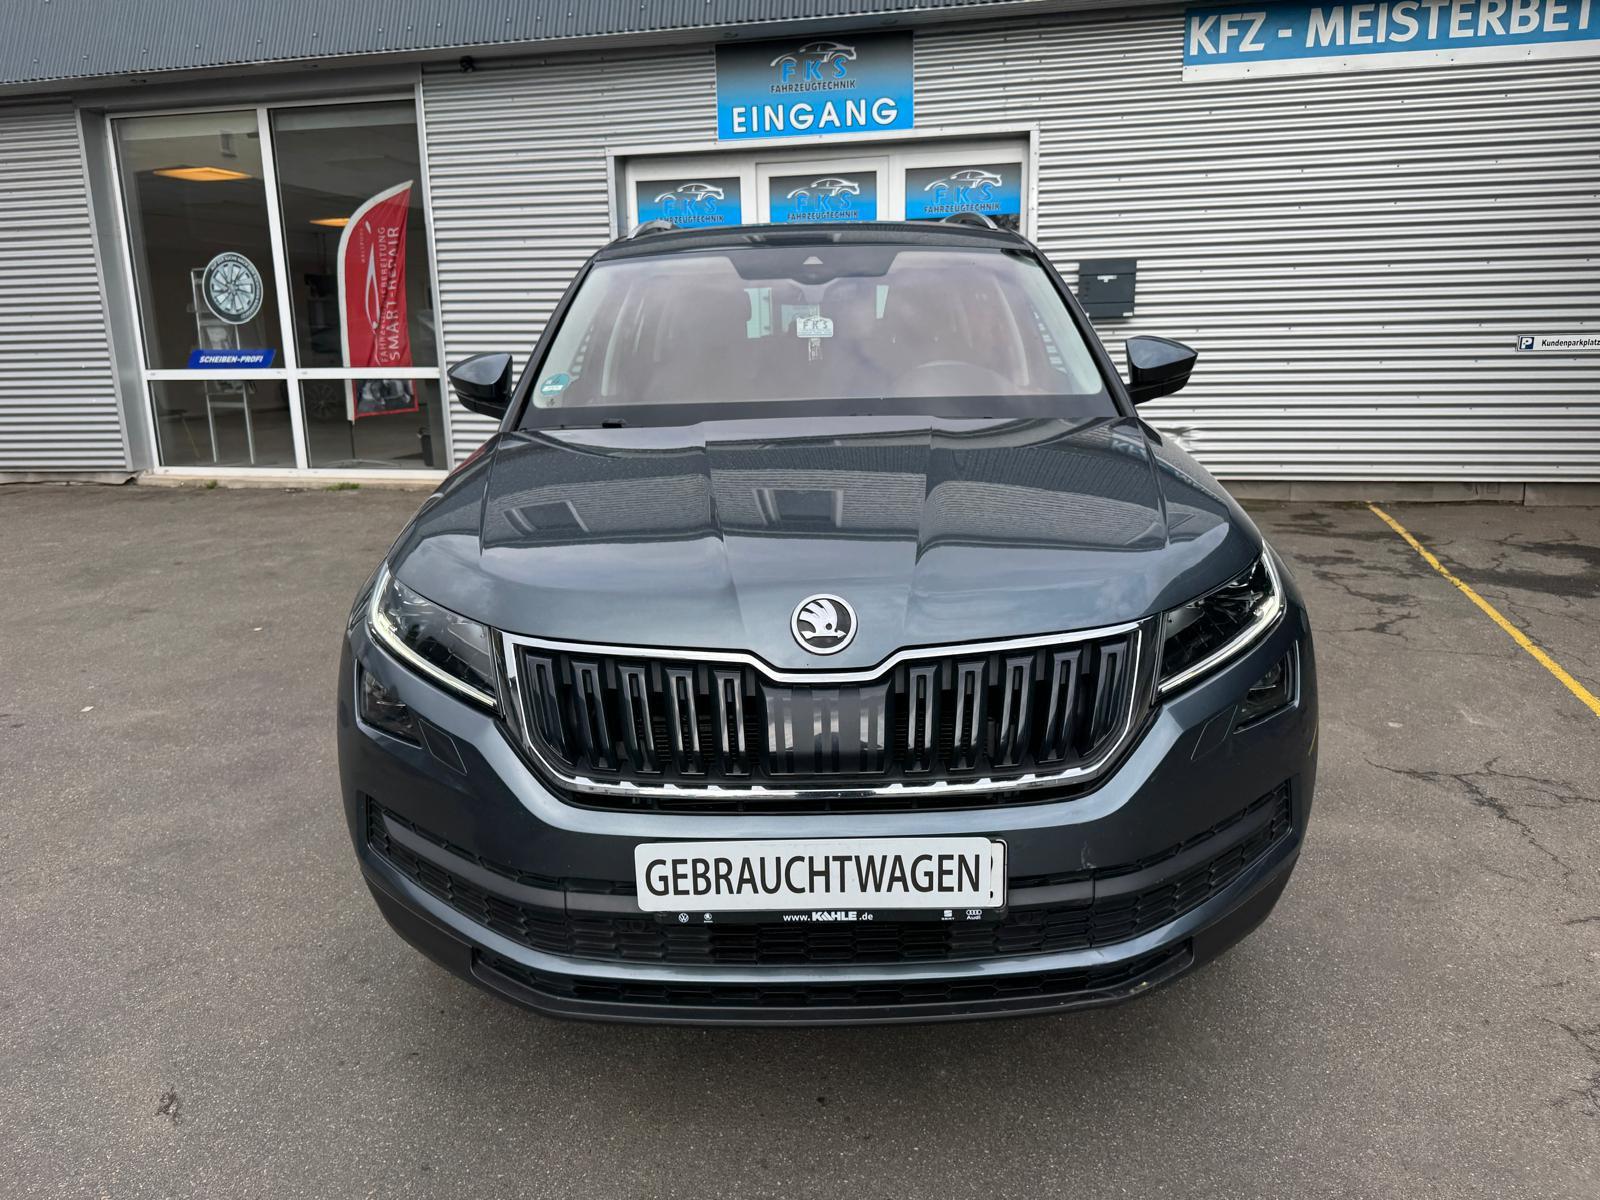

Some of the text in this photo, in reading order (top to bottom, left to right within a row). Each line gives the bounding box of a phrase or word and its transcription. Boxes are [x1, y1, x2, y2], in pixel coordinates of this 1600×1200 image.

[1189, 12, 1267, 56] KFZ
[770, 79, 856, 94] FAHRZEUGTECHNIK
[732, 97, 898, 134] EINGANG
[924, 203, 1001, 213] FAHRZEUGTECHNIK
[787, 210, 859, 221] FAHRZEUGTECHNIK
[1541, 338, 1600, 348] Kundenparkplatz
[199, 355, 264, 364] SCHEIBEN-PROFI
[645, 853, 980, 897] GEBRAUCHTWAGEN
